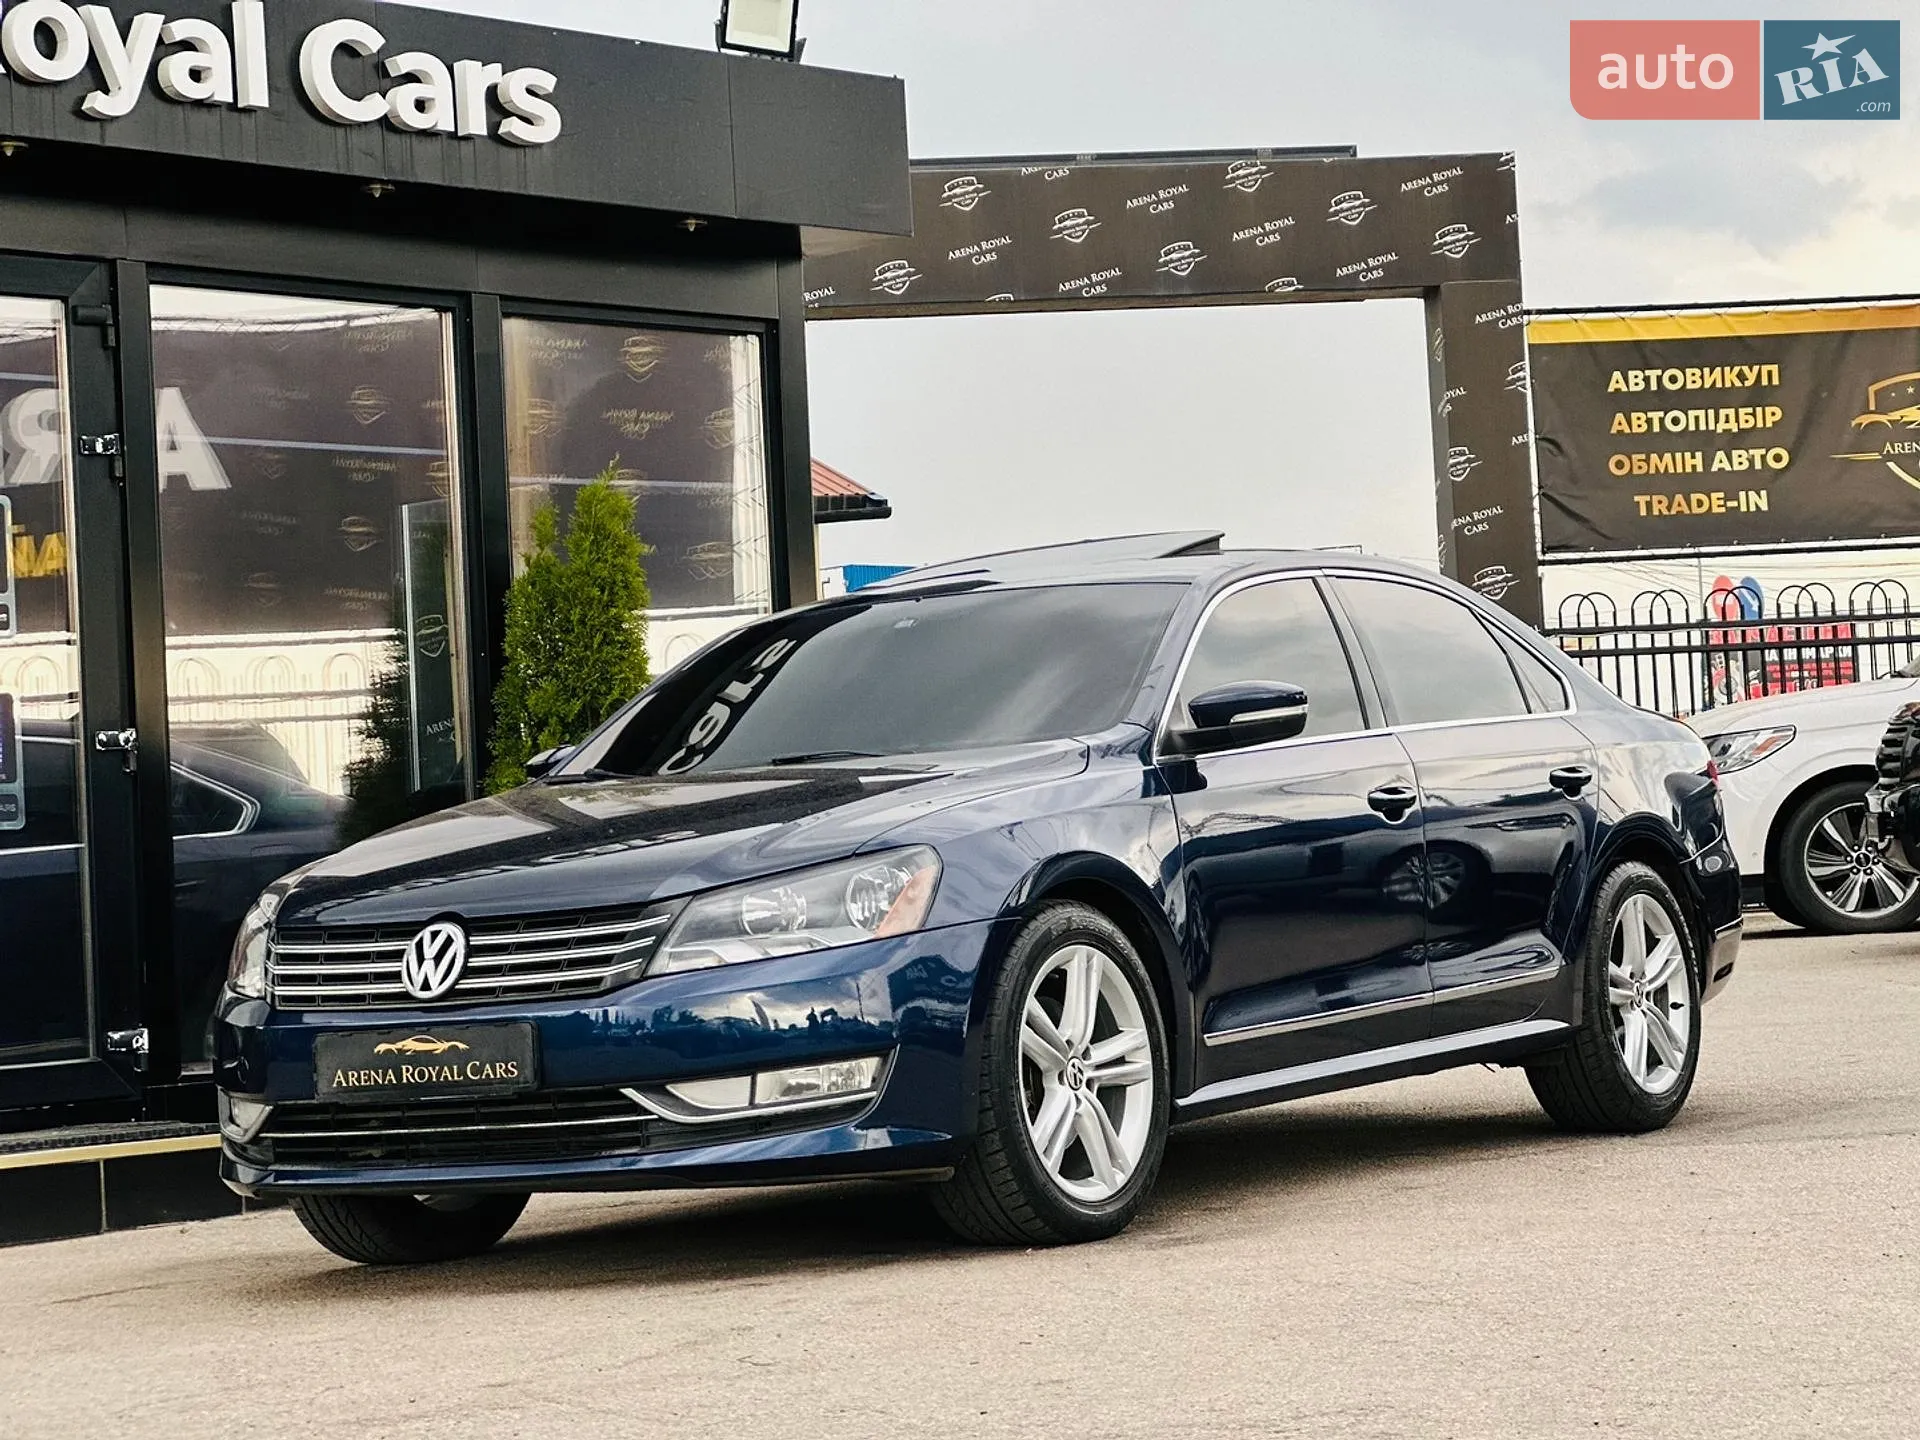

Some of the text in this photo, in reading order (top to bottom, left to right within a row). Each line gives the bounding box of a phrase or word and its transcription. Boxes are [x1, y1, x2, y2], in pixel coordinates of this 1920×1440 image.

[0, 0, 562, 147] oyal Cars
[1607, 364, 1780, 393] АВТОВИКУП
[1609, 405, 1783, 434] АВТОПІДБІР
[1608, 447, 1790, 477] ОБМІН АВТО
[1633, 490, 1769, 517] TRADE-IN
[332, 1060, 519, 1088] ARENA ROYAL CARS
